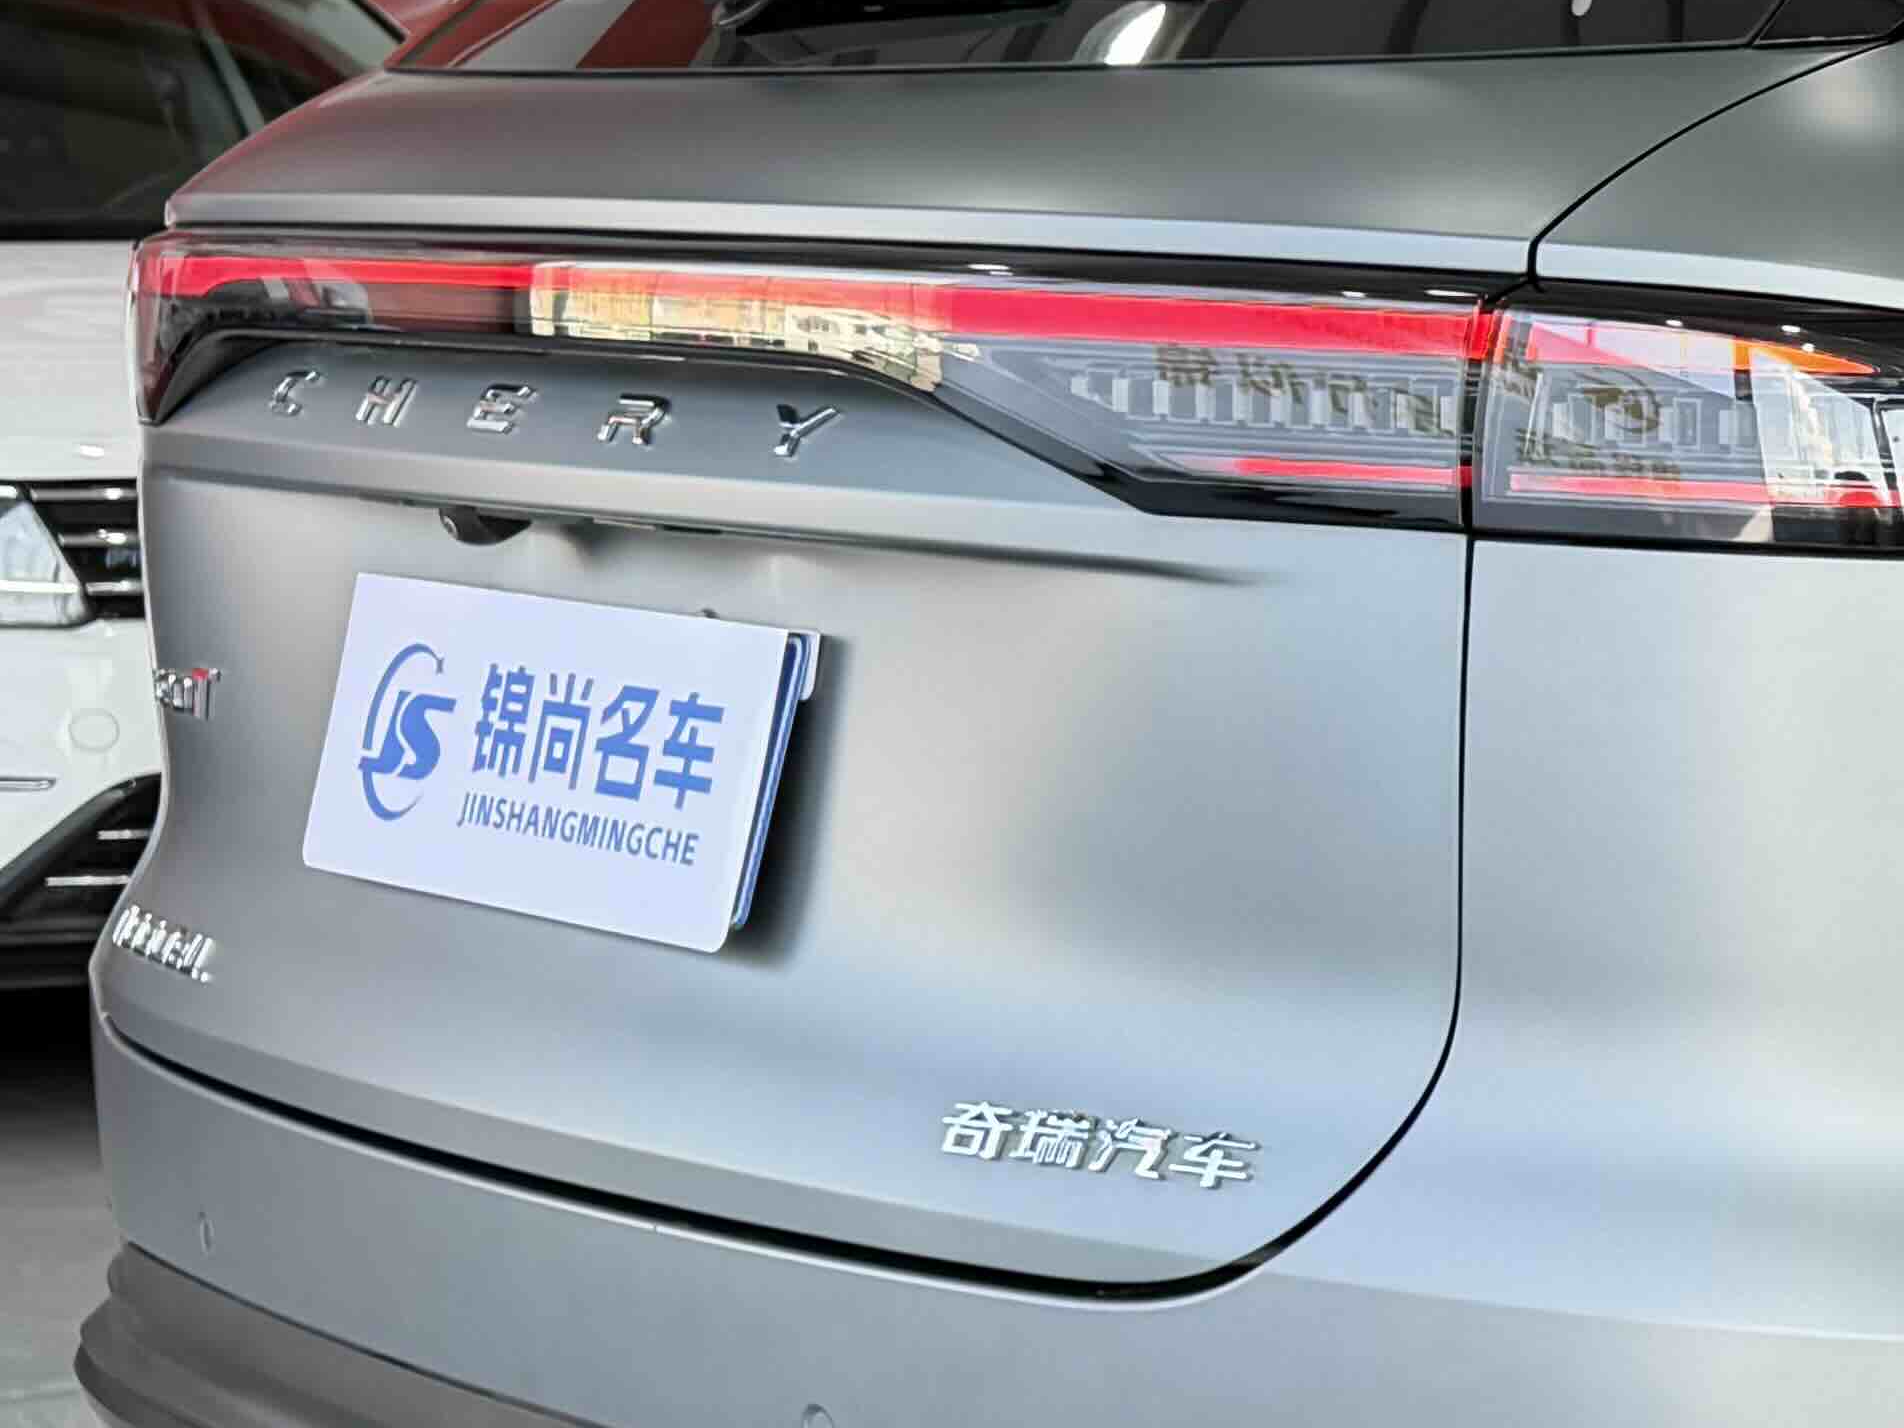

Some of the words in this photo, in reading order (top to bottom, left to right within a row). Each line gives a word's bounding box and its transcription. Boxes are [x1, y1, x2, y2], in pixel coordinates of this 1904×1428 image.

[269, 369, 844, 458] CHERY
[472, 663, 724, 811] 锦尚名车
[457, 792, 699, 867] JINSHANGMINGCHE
[941, 1101, 1258, 1189] 奇瑞汽车
